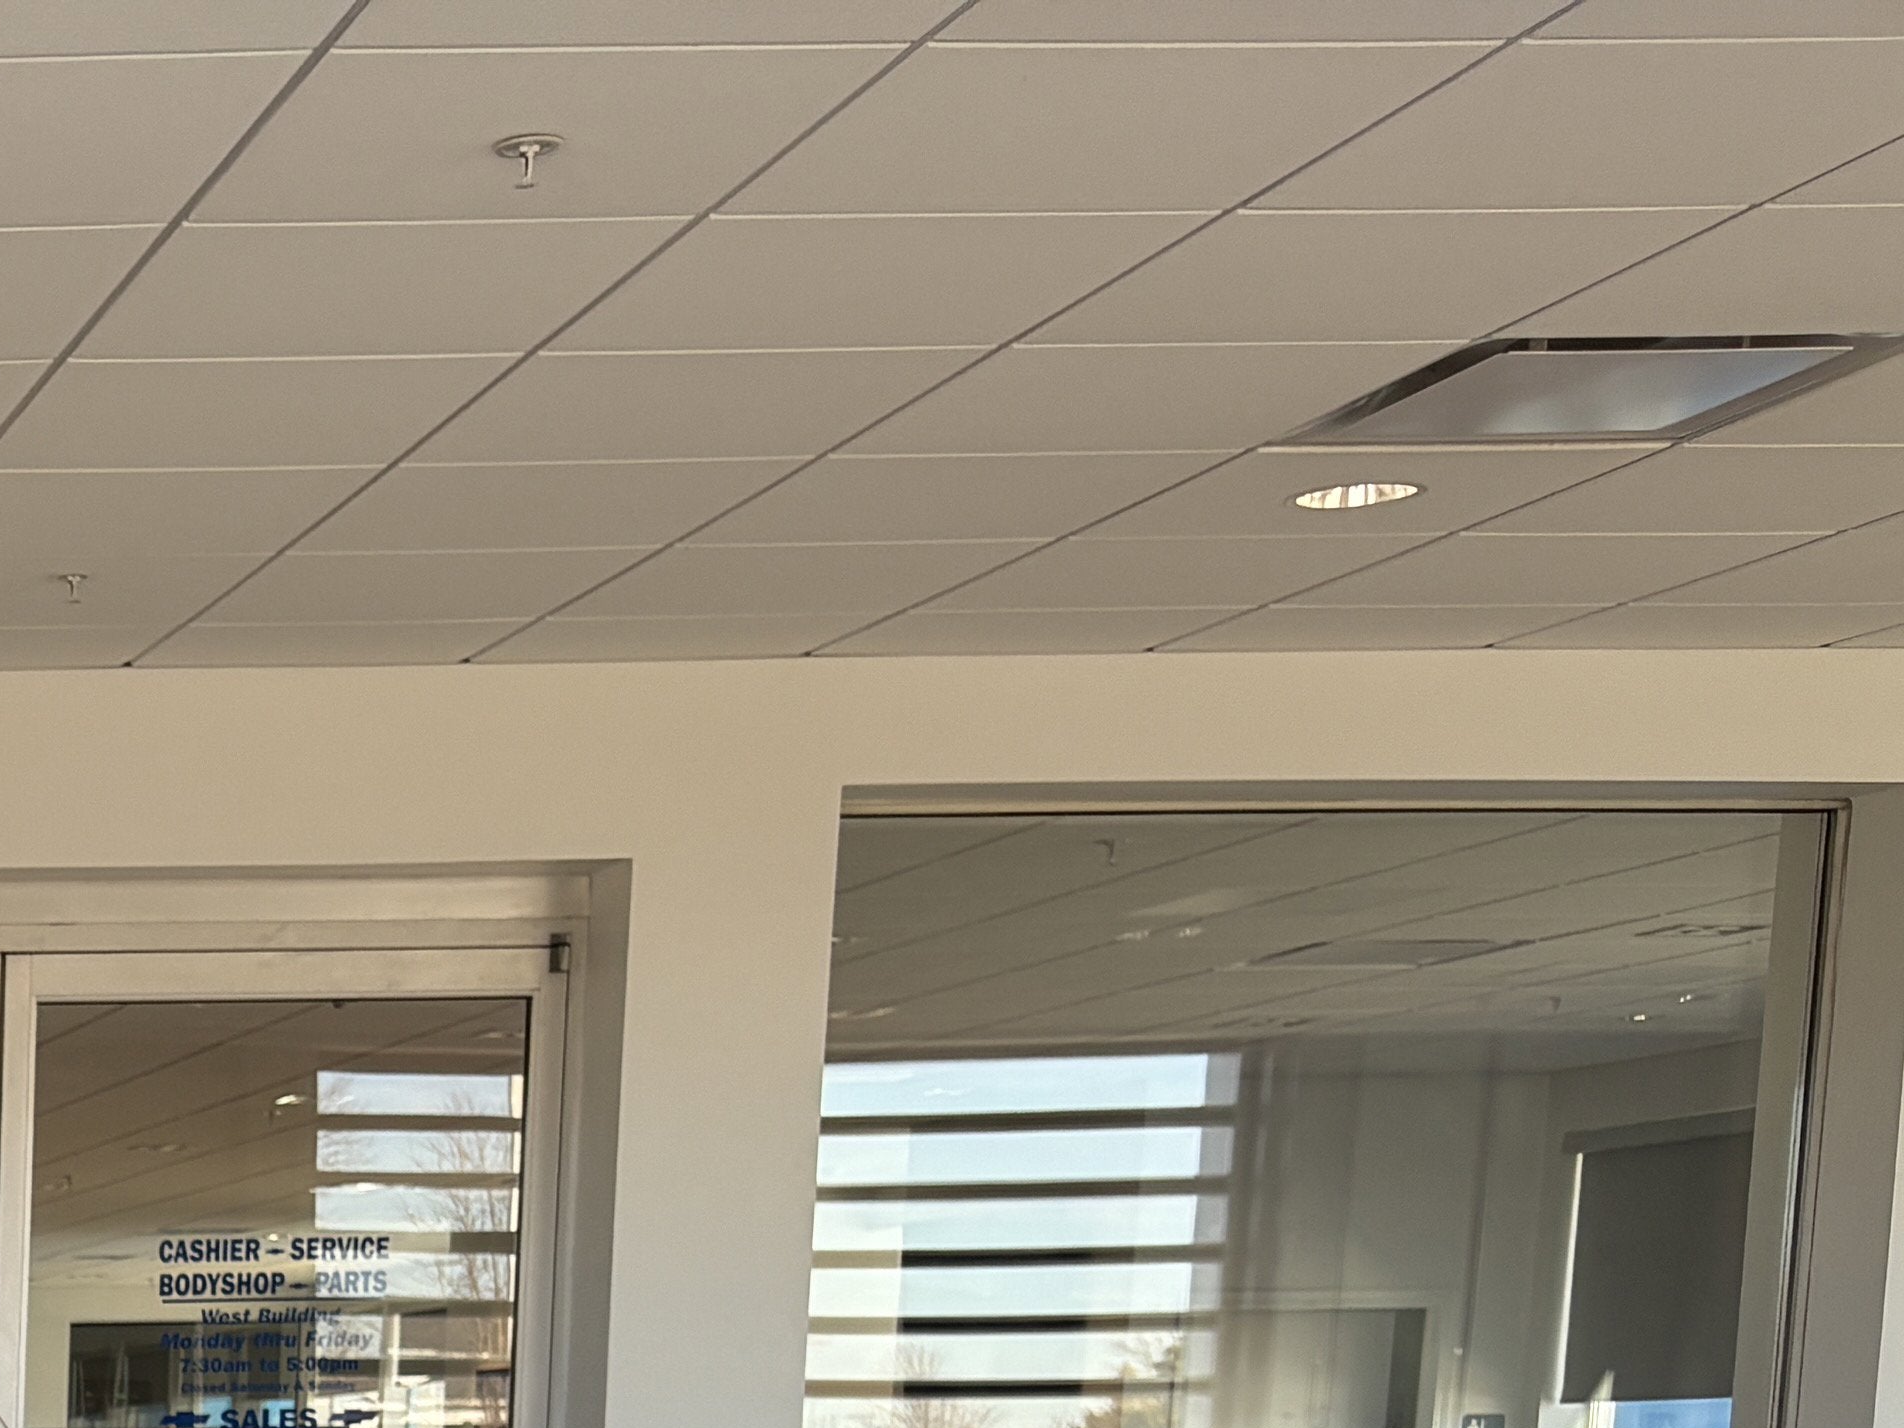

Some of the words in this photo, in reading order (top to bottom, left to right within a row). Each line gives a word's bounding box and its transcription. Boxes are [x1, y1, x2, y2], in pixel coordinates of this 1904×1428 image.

[159, 1239, 260, 1263] CASHIER
[289, 1237, 390, 1260] SERVICE
[159, 1272, 286, 1296] BODYSHOP
[315, 1271, 388, 1293] PARTS
[201, 1308, 251, 1325] West
[259, 1307, 342, 1326] Building
[160, 1333, 246, 1352] Monday
[254, 1332, 297, 1349] thru
[304, 1329, 374, 1350] Friday
[180, 1358, 252, 1373] 7:30am
[260, 1356, 280, 1373] to
[287, 1357, 359, 1374] 5:00pm
